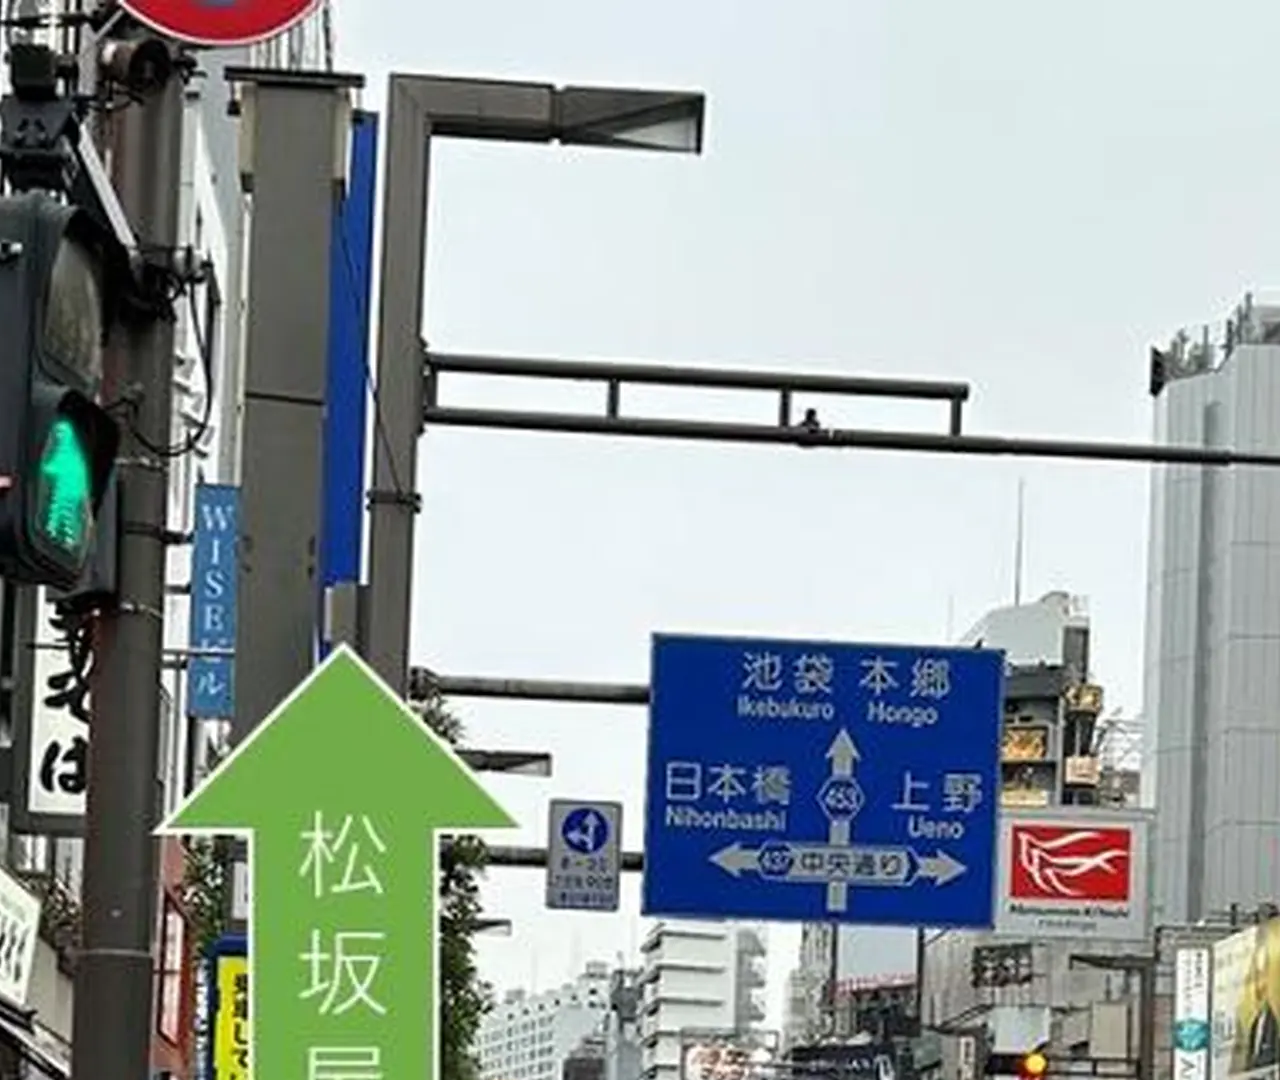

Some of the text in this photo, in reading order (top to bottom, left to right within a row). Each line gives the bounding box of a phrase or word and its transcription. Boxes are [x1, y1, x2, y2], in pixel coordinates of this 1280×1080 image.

[743, 652, 951, 699] 池袋 本郷
[737, 696, 939, 728] Ikebukuro Hongo
[665, 761, 792, 805] 日本橋
[890, 770, 983, 813] 上野
[665, 805, 787, 832] Nihonbashi
[907, 814, 964, 840] Ueno
[800, 852, 902, 877] 中央通り
